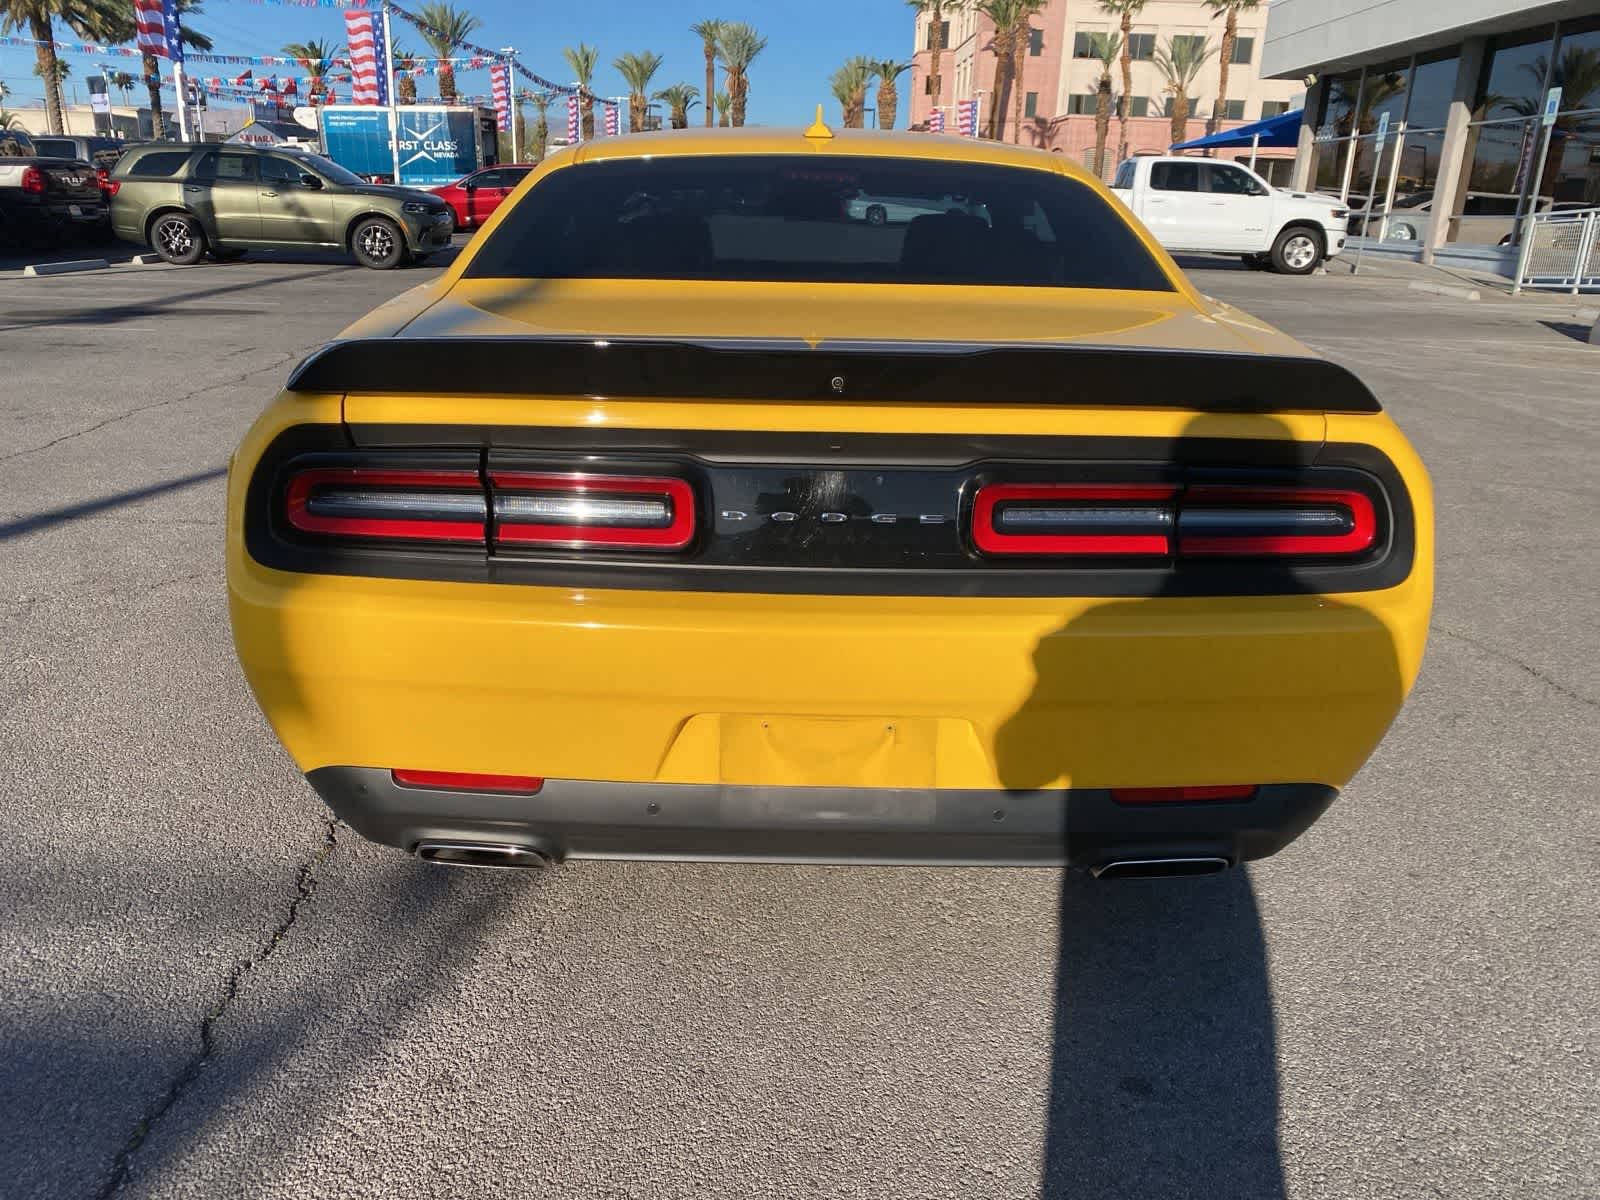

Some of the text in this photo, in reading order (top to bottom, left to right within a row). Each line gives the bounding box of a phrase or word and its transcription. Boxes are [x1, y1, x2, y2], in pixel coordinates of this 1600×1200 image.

[388, 140, 458, 151] FRST CLASS
[433, 151, 459, 159] NEVADA
[722, 511, 945, 524] DODGE
